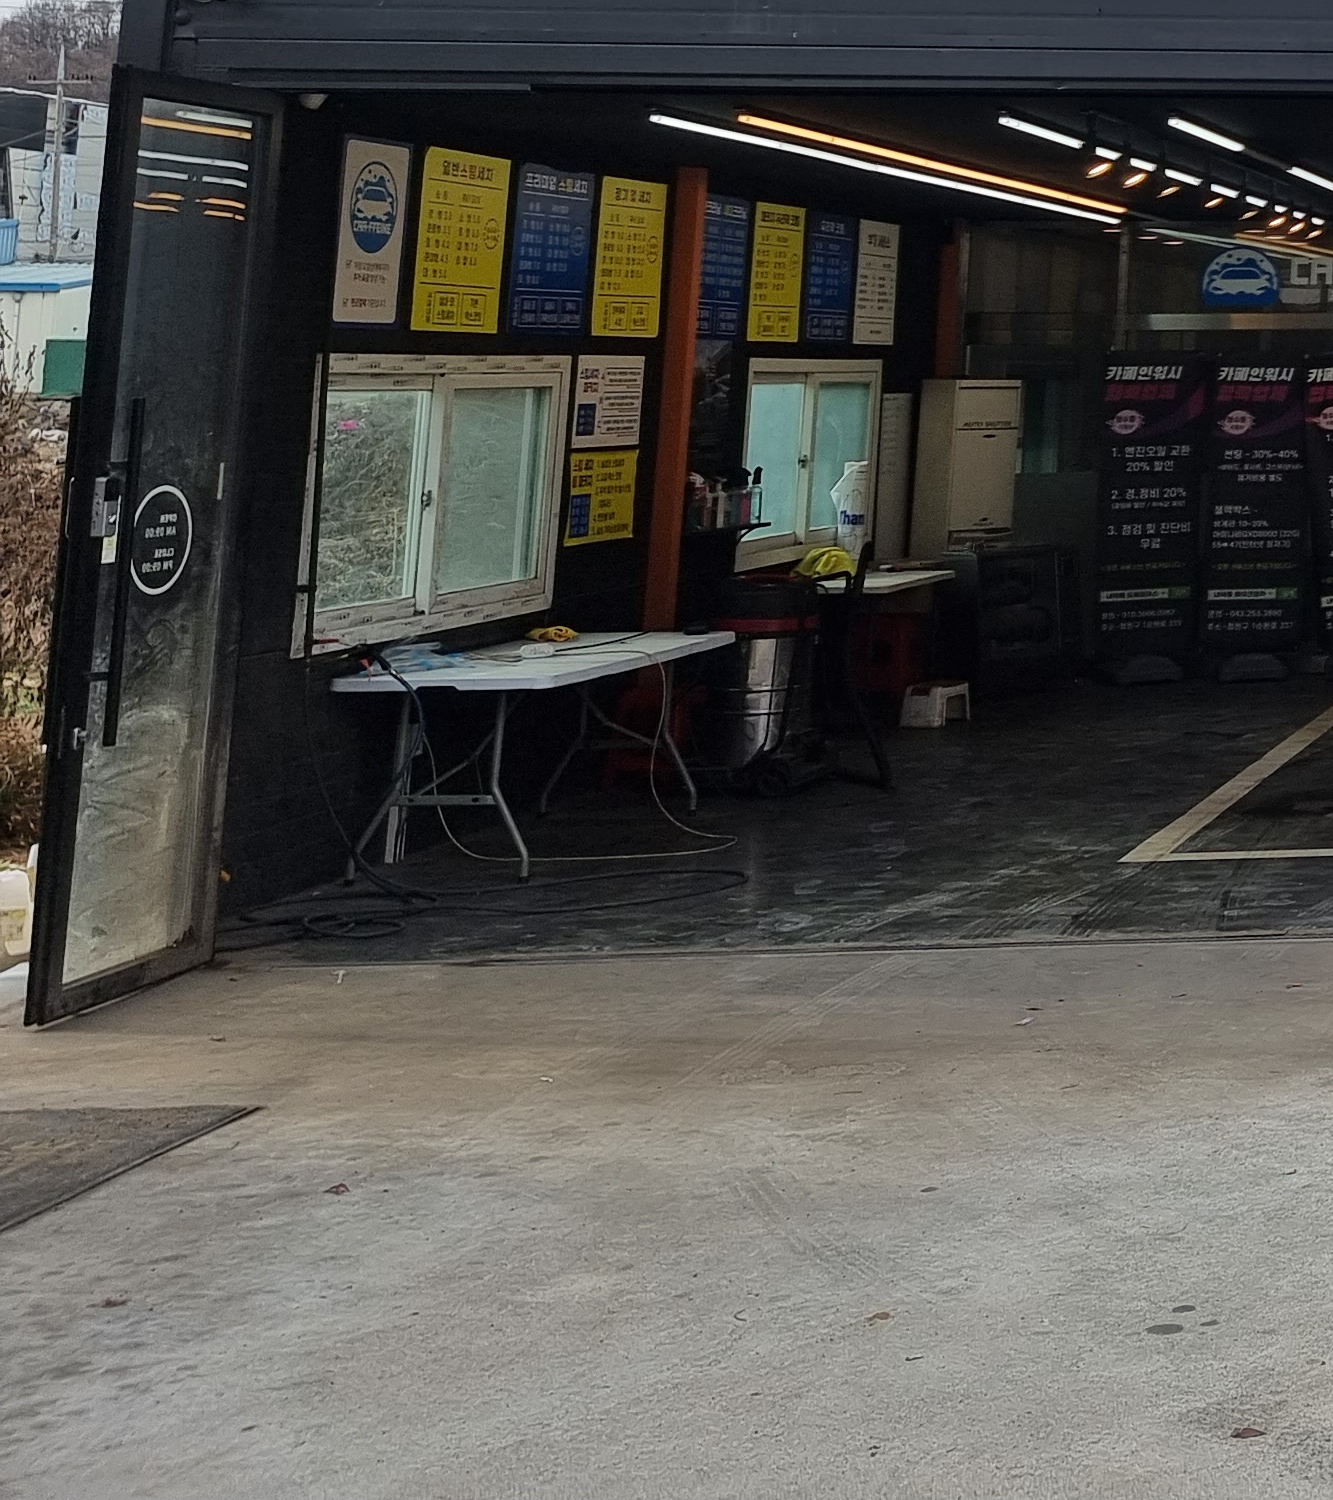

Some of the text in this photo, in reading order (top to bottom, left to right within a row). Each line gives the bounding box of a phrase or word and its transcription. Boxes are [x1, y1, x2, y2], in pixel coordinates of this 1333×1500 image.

[1105, 365, 1184, 381] 카페인워시
[1217, 366, 1295, 382] 카페인워시
[1125, 461, 1150, 472] 20%
[1163, 487, 1187, 498] 20%
